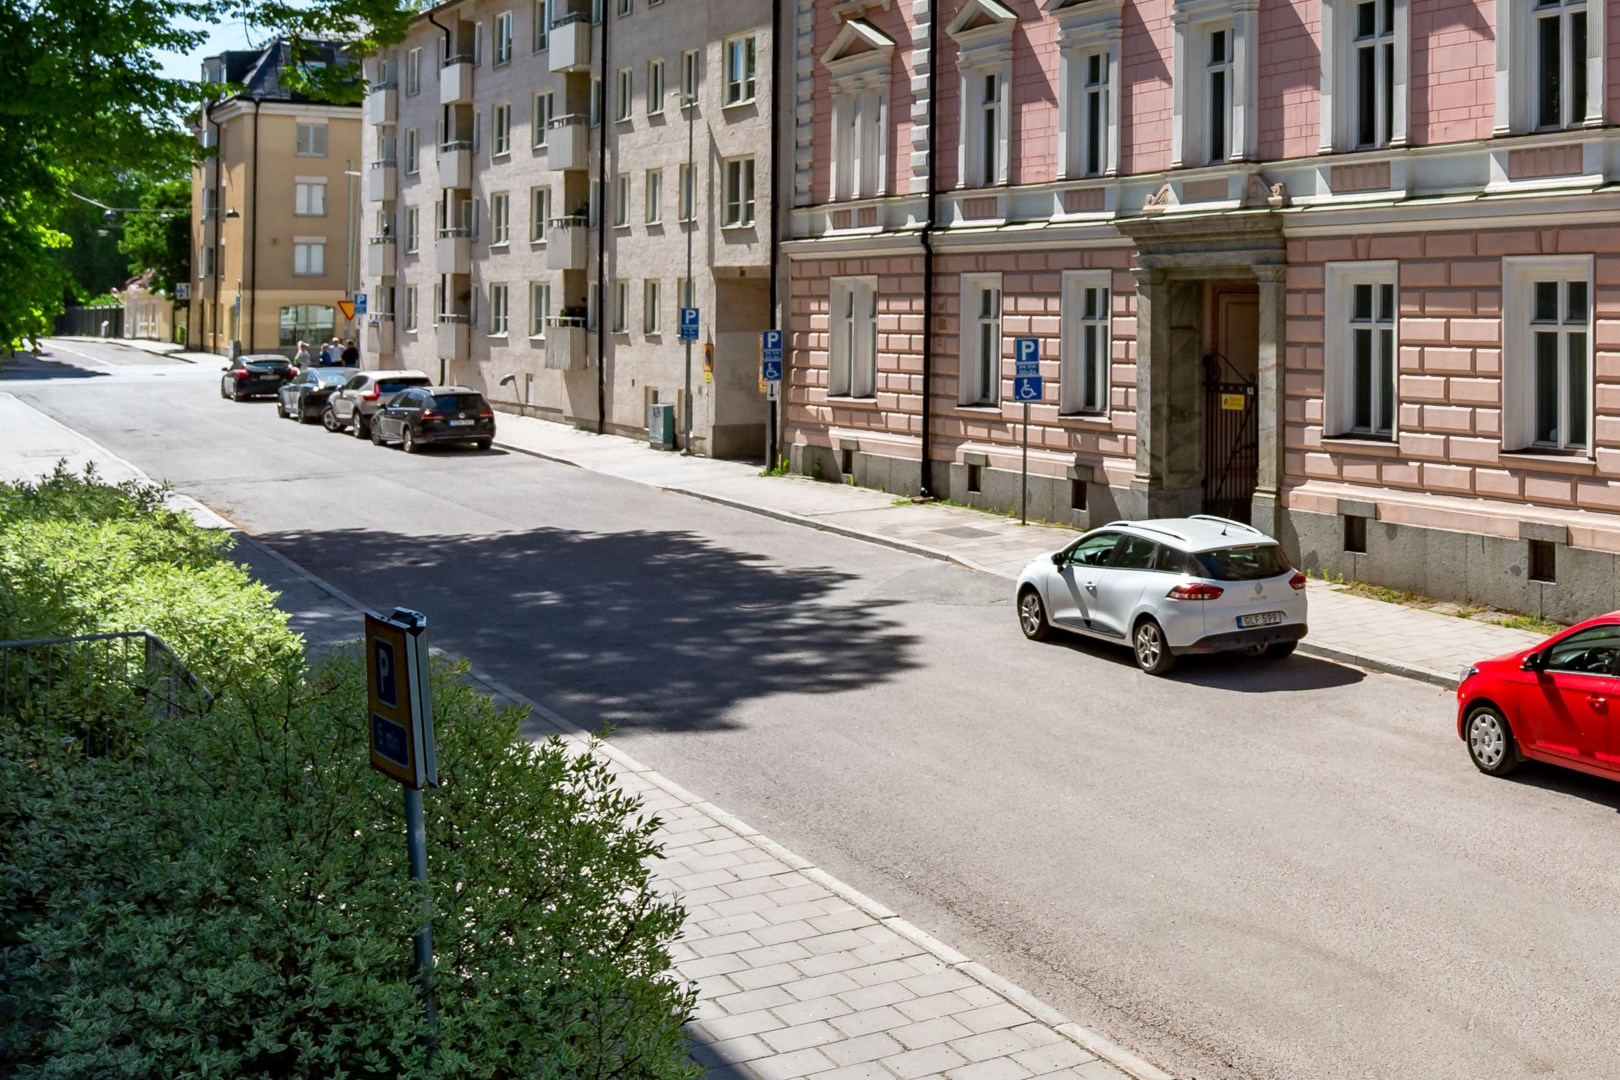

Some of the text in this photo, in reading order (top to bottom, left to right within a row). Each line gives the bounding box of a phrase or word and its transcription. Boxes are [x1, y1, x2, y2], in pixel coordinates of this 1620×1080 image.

[357, 294, 365, 304] P
[685, 309, 697, 324] P
[767, 332, 779, 348] P
[1021, 340, 1035, 360] P
[1262, 613, 1277, 623] 599
[378, 648, 389, 693] P
